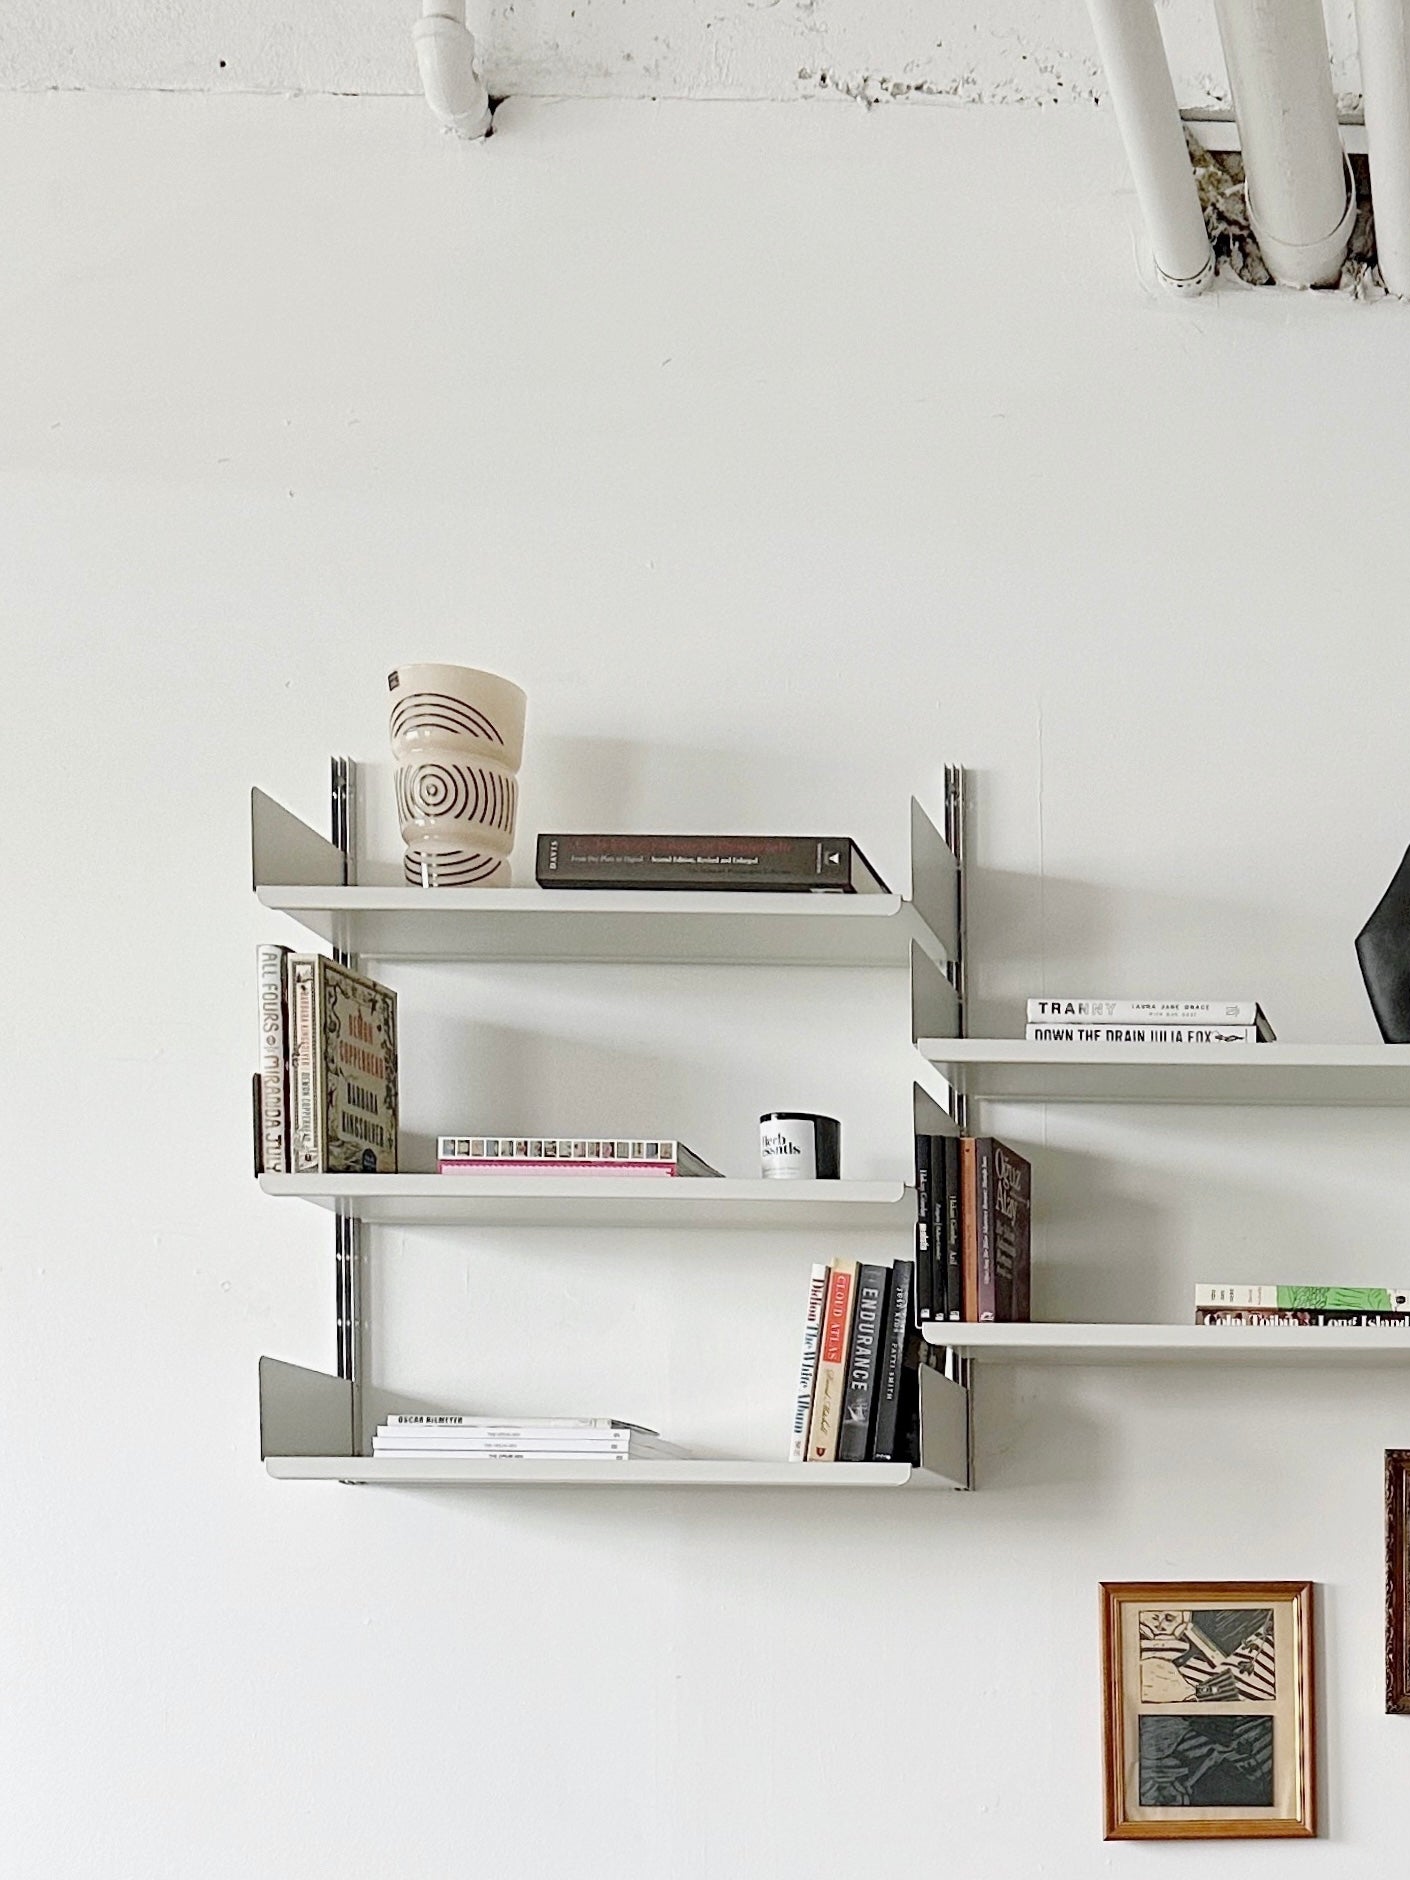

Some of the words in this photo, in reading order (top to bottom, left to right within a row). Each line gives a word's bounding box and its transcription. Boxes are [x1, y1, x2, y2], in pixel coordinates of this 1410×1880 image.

[549, 840, 559, 870] DAVIS
[262, 952, 278, 978] ALL
[262, 986, 280, 1033] FOURS
[1038, 1002, 1117, 1016] TRANNY
[1035, 1029, 1074, 1041] DOWN
[1078, 1029, 1102, 1041] THE
[1106, 1030, 1145, 1042] DRAIN
[1187, 1031, 1212, 1043] FOX
[264, 1054, 282, 1129] MIRANDA
[265, 1135, 282, 1173] JULY
[807, 1278, 825, 1322] Didion
[833, 1275, 847, 1318] CLOUD
[804, 1324, 818, 1350] The
[851, 1288, 880, 1392] ENDURANCE
[1361, 1315, 1410, 1327] Island
[828, 1322, 842, 1362] ATLAS
[800, 1351, 816, 1389] White
[794, 1394, 811, 1434] Album
